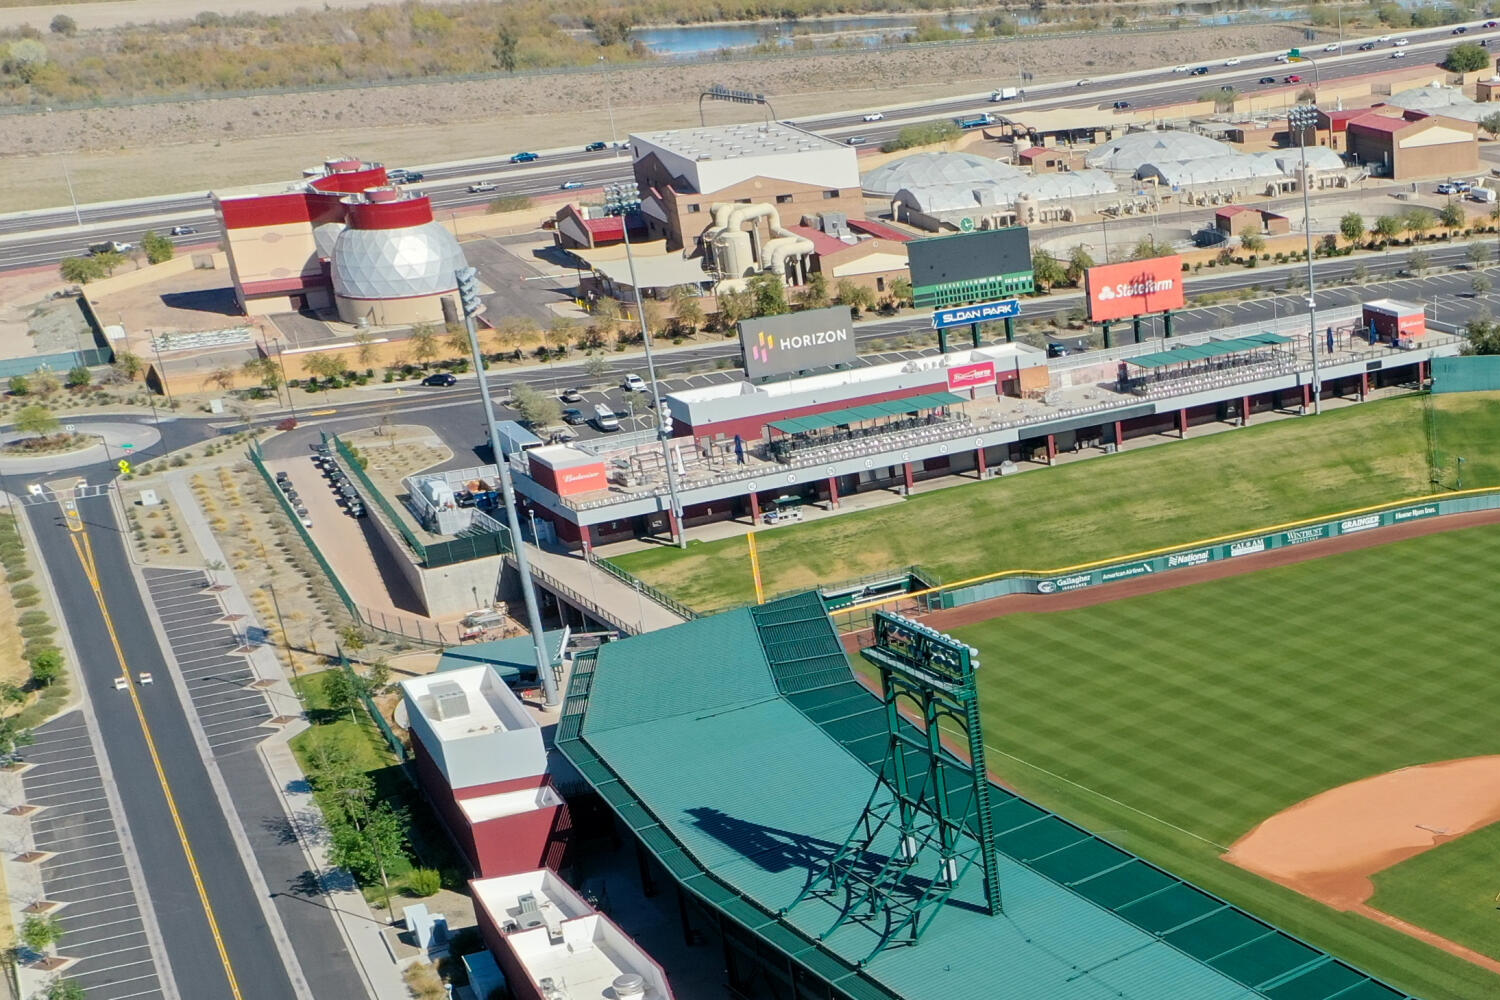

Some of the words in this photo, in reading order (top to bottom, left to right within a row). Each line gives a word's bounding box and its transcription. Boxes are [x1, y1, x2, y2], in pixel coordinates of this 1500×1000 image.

[1116, 282, 1145, 298] State
[1145, 279, 1173, 293] Farm
[942, 310, 981, 323] SLOAN
[982, 304, 1012, 316] PARK
[780, 328, 847, 350] HORIZON
[1341, 515, 1380, 530] GRAINGER
[1287, 527, 1323, 541] WINTRUST
[1177, 550, 1209, 564] National
[1126, 567, 1145, 576] Airlines
[1056, 575, 1092, 587] Gallagher
